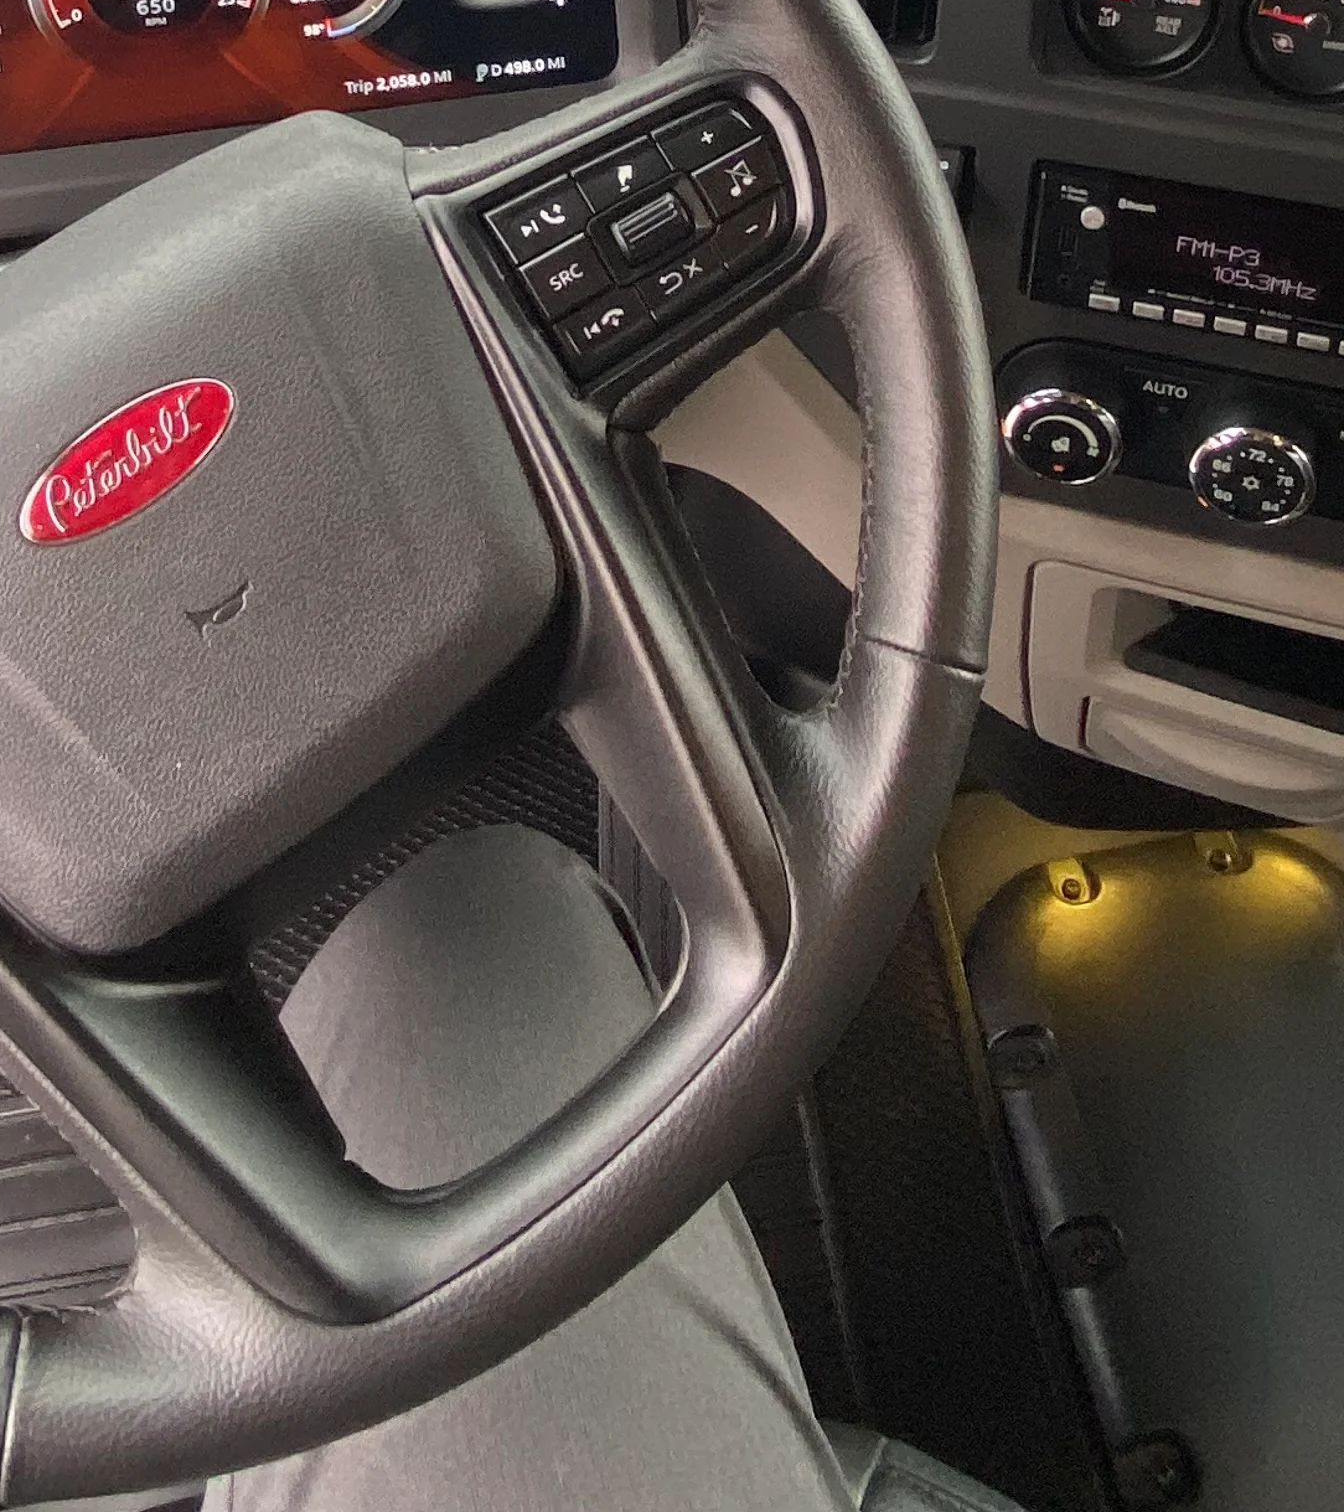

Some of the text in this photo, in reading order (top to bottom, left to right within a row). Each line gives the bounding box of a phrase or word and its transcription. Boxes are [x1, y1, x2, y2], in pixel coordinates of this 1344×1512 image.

[504, 59, 545, 75] 498.0
[549, 56, 565, 70] MI
[345, 70, 452, 94] Trip 2,058.0 MI
[1175, 235, 1261, 267] FM1-P3
[549, 263, 585, 292] SRC
[1212, 264, 1317, 301] 105.3MHz
[1142, 380, 1189, 400] AUTO
[46, 386, 203, 533] Peterbilt
